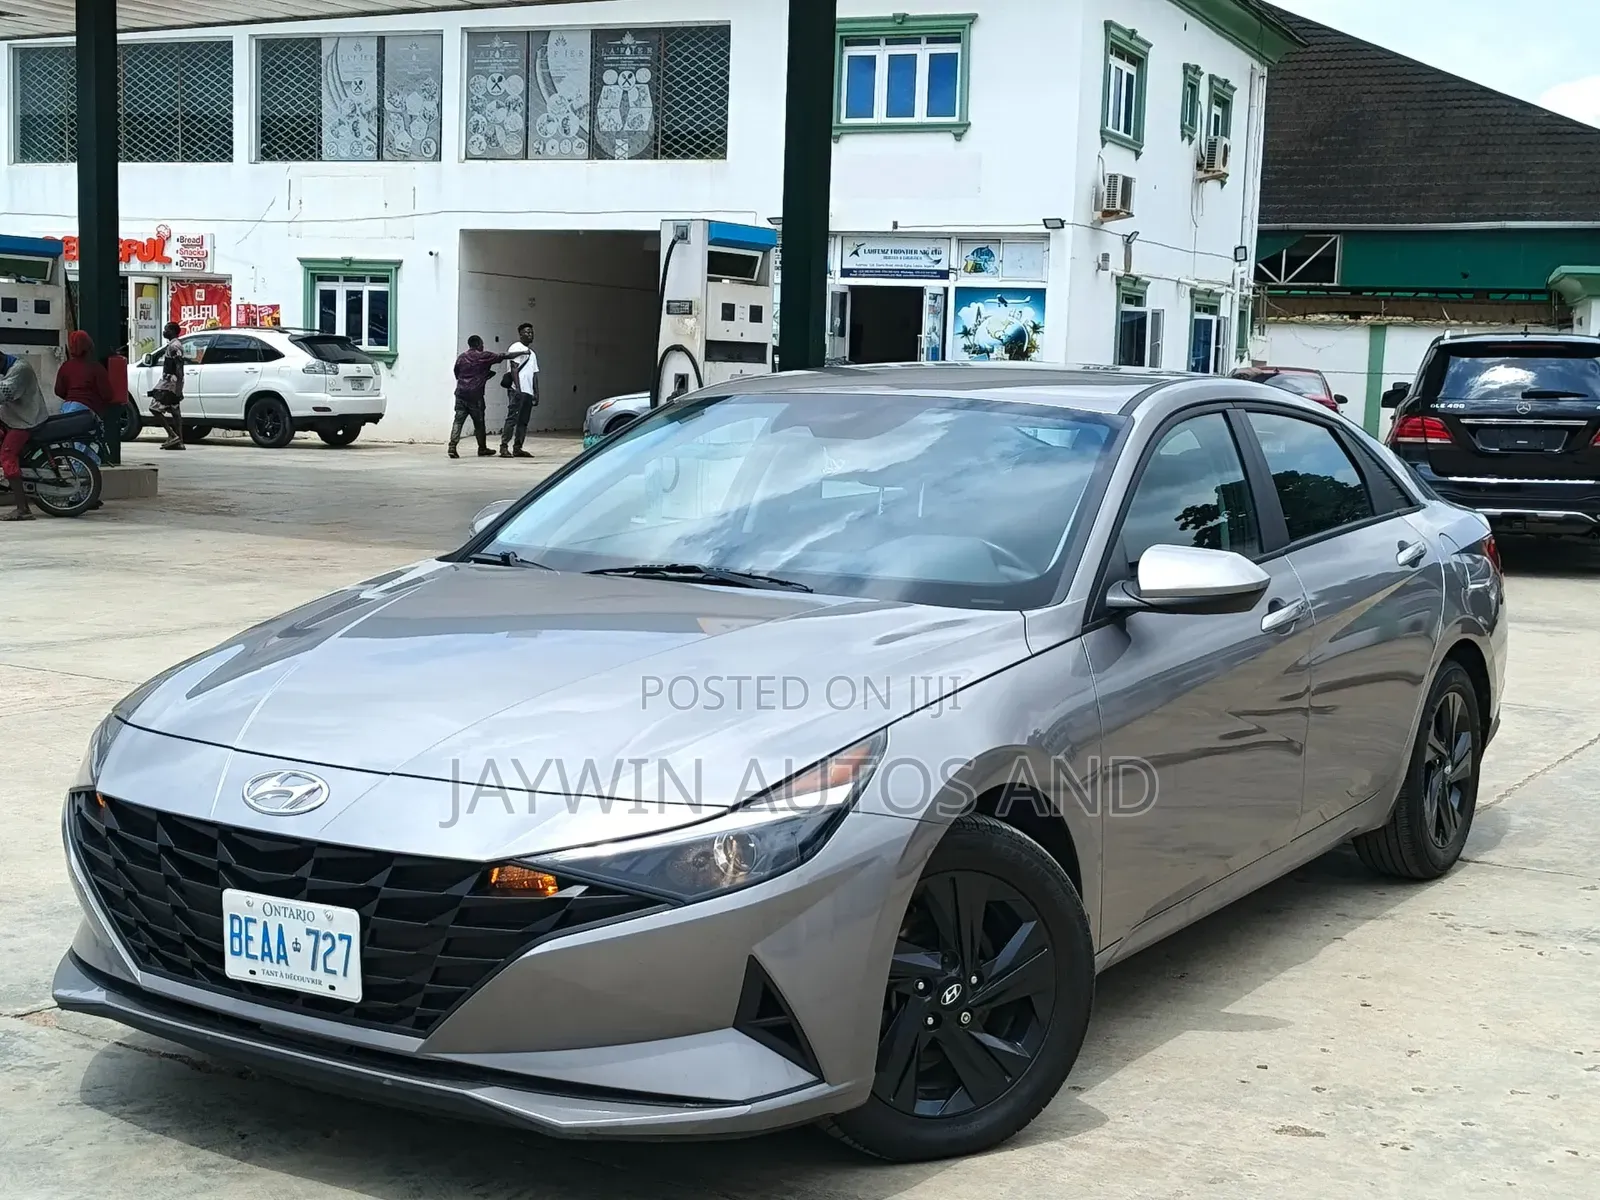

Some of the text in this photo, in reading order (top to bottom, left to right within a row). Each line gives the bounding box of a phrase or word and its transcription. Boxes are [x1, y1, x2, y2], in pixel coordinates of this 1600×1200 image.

[179, 235, 201, 244] Bread
[43, 235, 172, 264] EFUL
[179, 249, 205, 257] Snacks
[179, 260, 204, 268] Drinks
[262, 901, 316, 924] ONTARIO
[229, 913, 353, 978] BEAA 727
[261, 968, 279, 978] TANT
